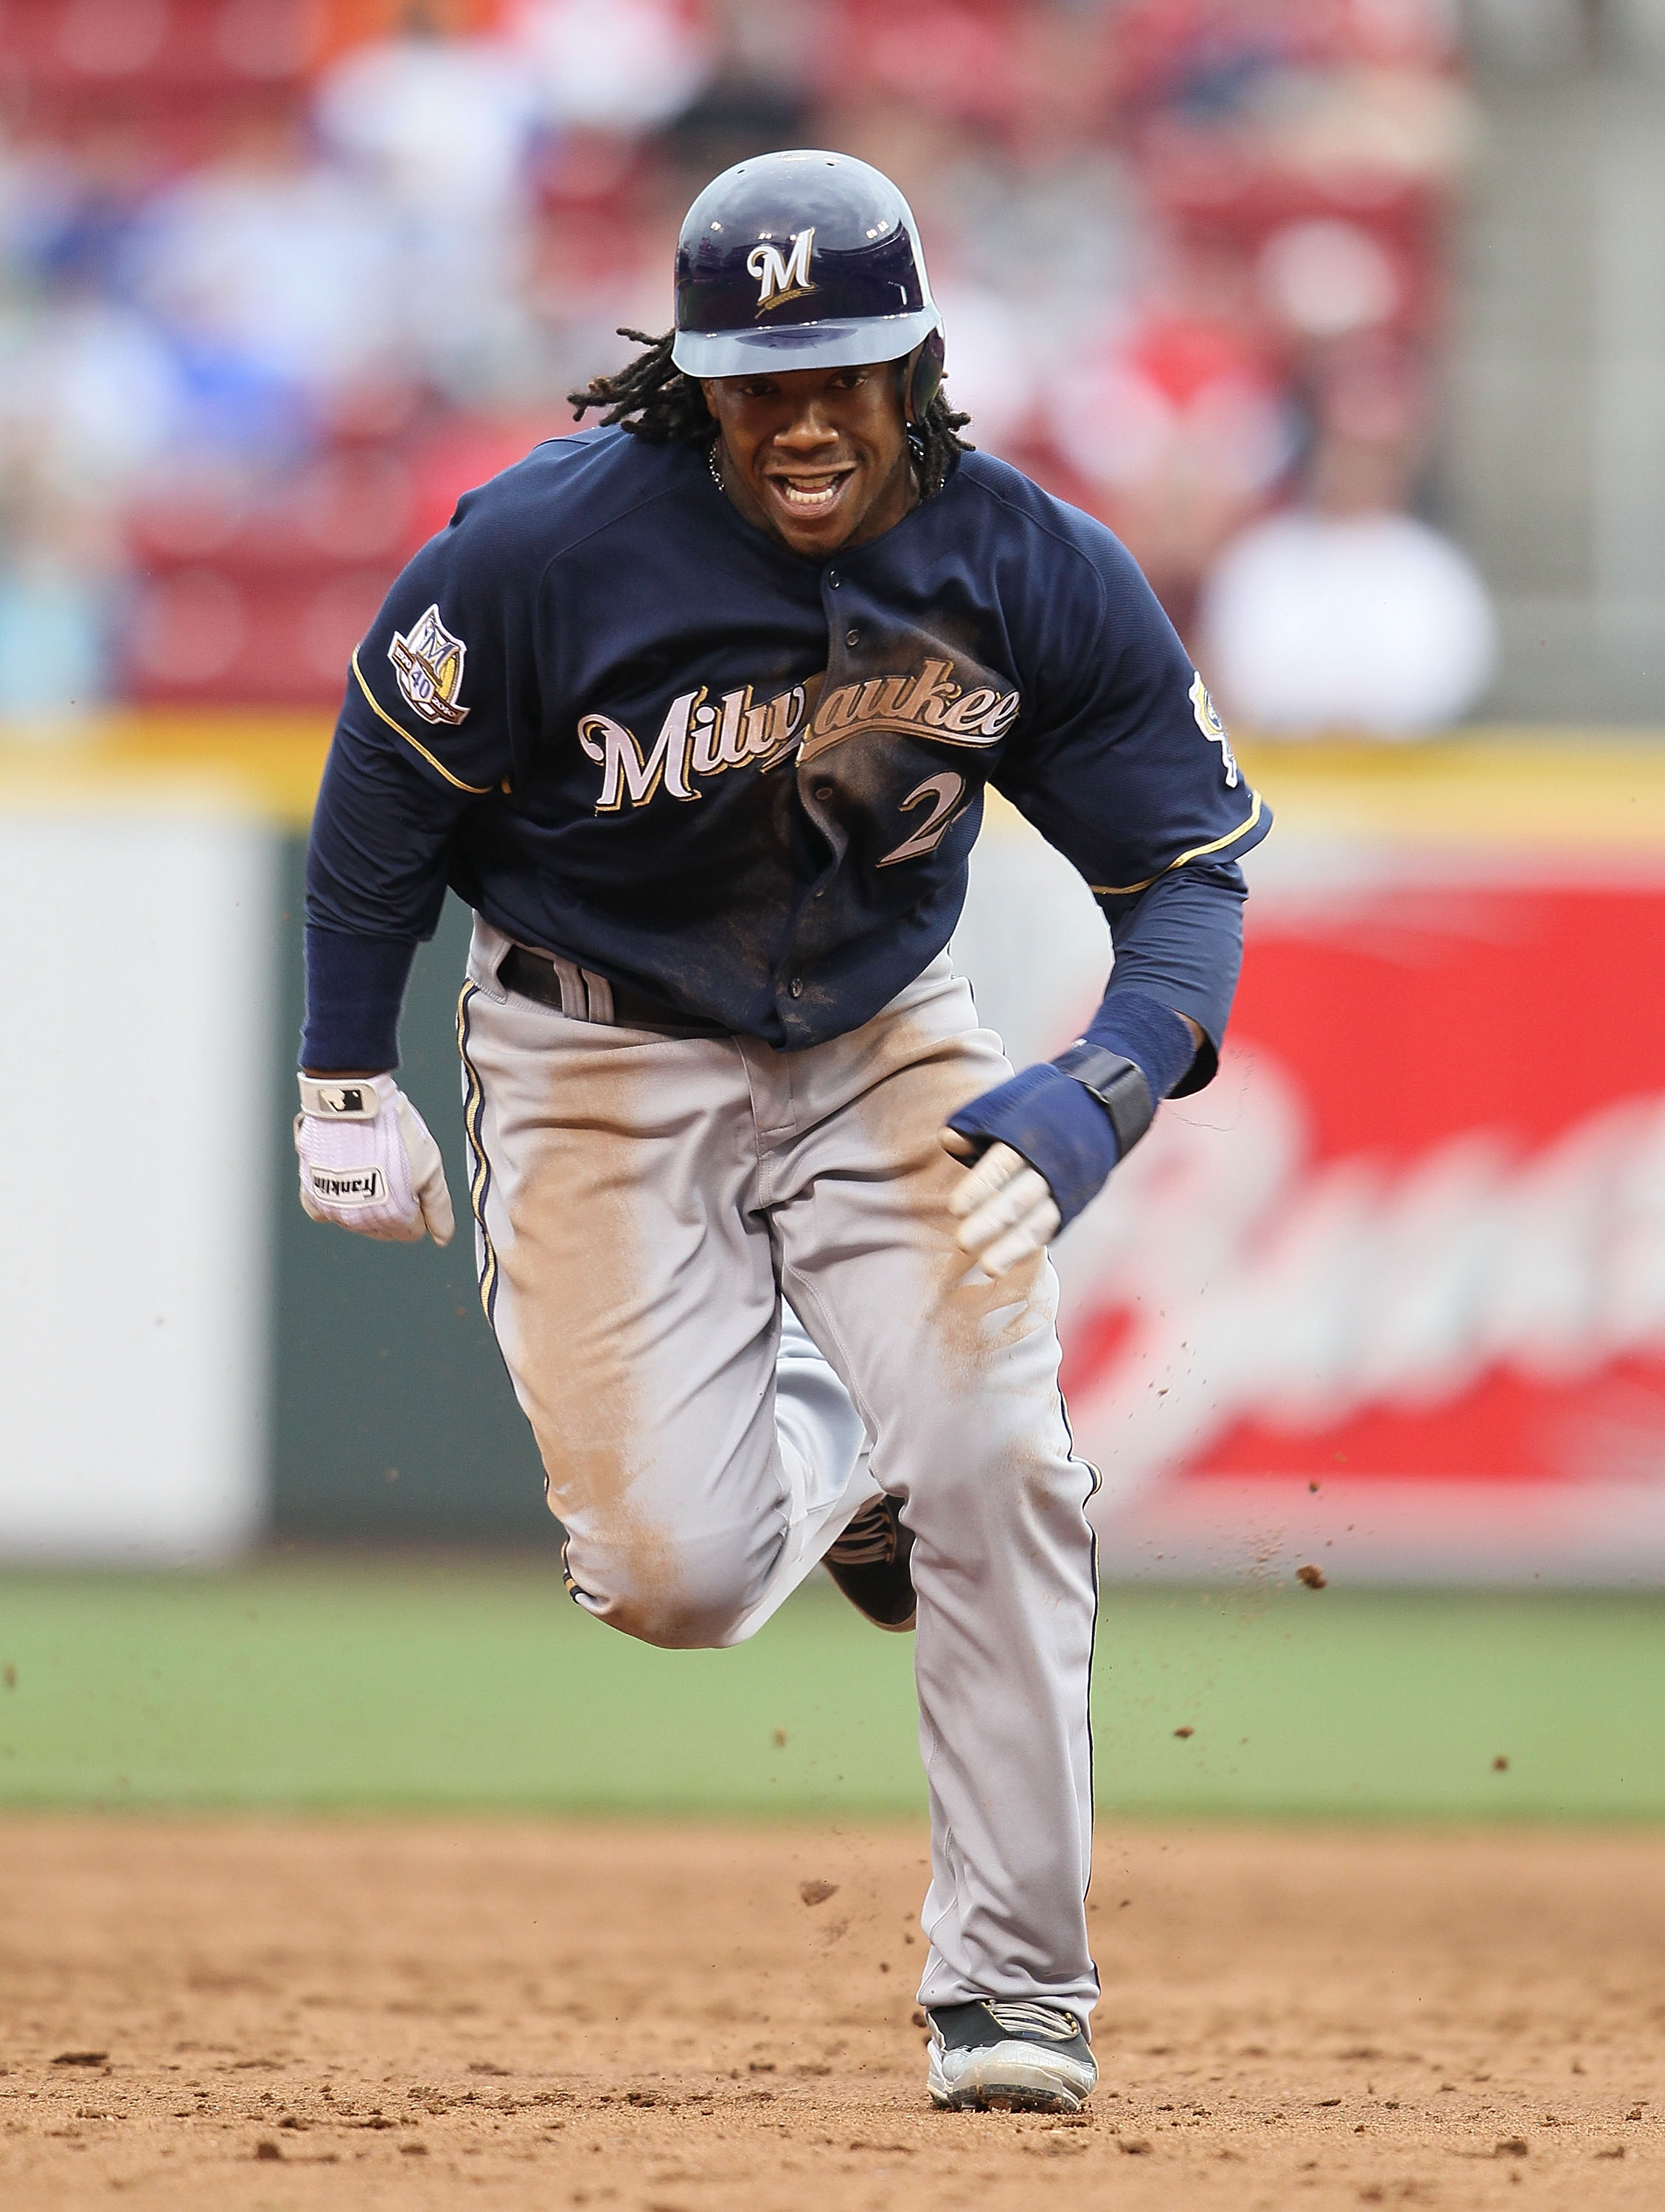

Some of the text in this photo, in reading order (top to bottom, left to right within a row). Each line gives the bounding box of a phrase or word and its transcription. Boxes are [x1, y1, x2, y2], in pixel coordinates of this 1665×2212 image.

[747, 227, 815, 306] M
[411, 671, 431, 698] 40
[431, 696, 456, 717] 2010
[577, 656, 1021, 816] Milwaukee
[875, 771, 973, 868] 2
